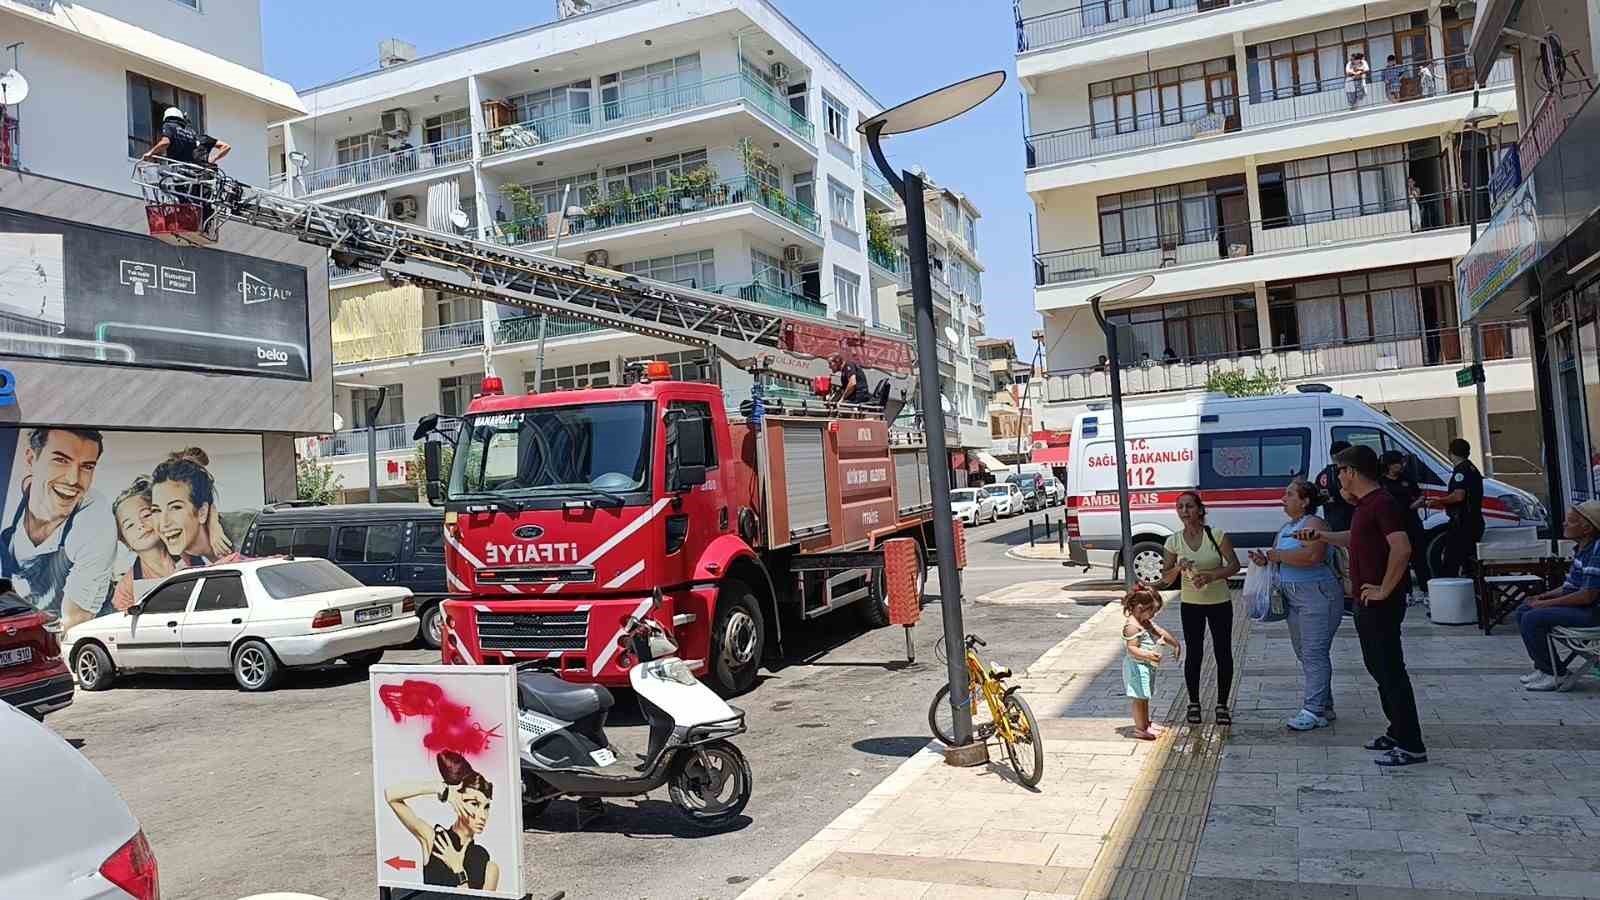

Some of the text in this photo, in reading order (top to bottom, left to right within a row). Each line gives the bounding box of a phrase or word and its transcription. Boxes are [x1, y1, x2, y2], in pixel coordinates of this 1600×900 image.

[237, 281, 287, 300] CRYSTAL
[257, 346, 288, 362] beko
[1129, 440, 1150, 450] T.C.
[1088, 448, 1193, 467] SAĞL BAKANLIĞI
[1127, 466, 1155, 486] 112
[1081, 492, 1159, 506] AMBUANS
